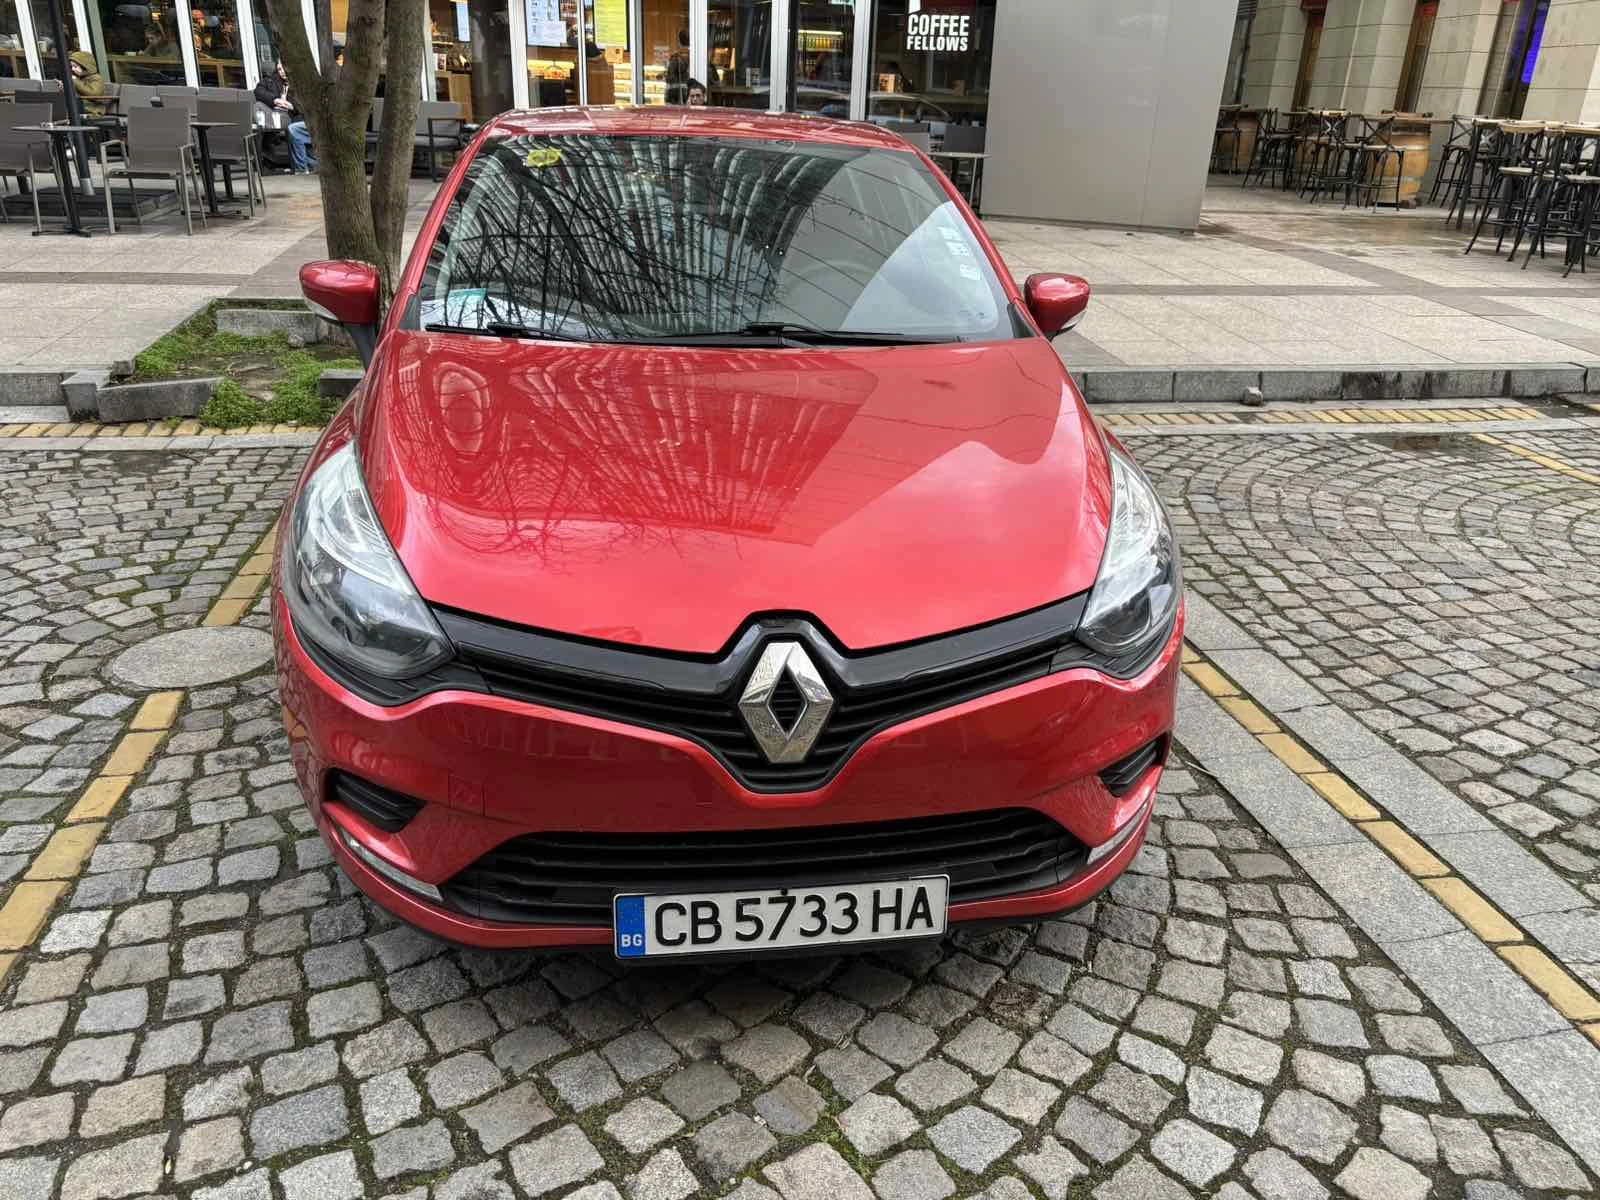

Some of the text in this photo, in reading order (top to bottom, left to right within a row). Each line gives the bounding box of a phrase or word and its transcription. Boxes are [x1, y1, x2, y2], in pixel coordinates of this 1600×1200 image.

[908, 14, 970, 36] COFFEE
[906, 36, 968, 52] FELLOWS
[654, 887, 934, 947] CB 5733 HA
[621, 934, 643, 947] BG
